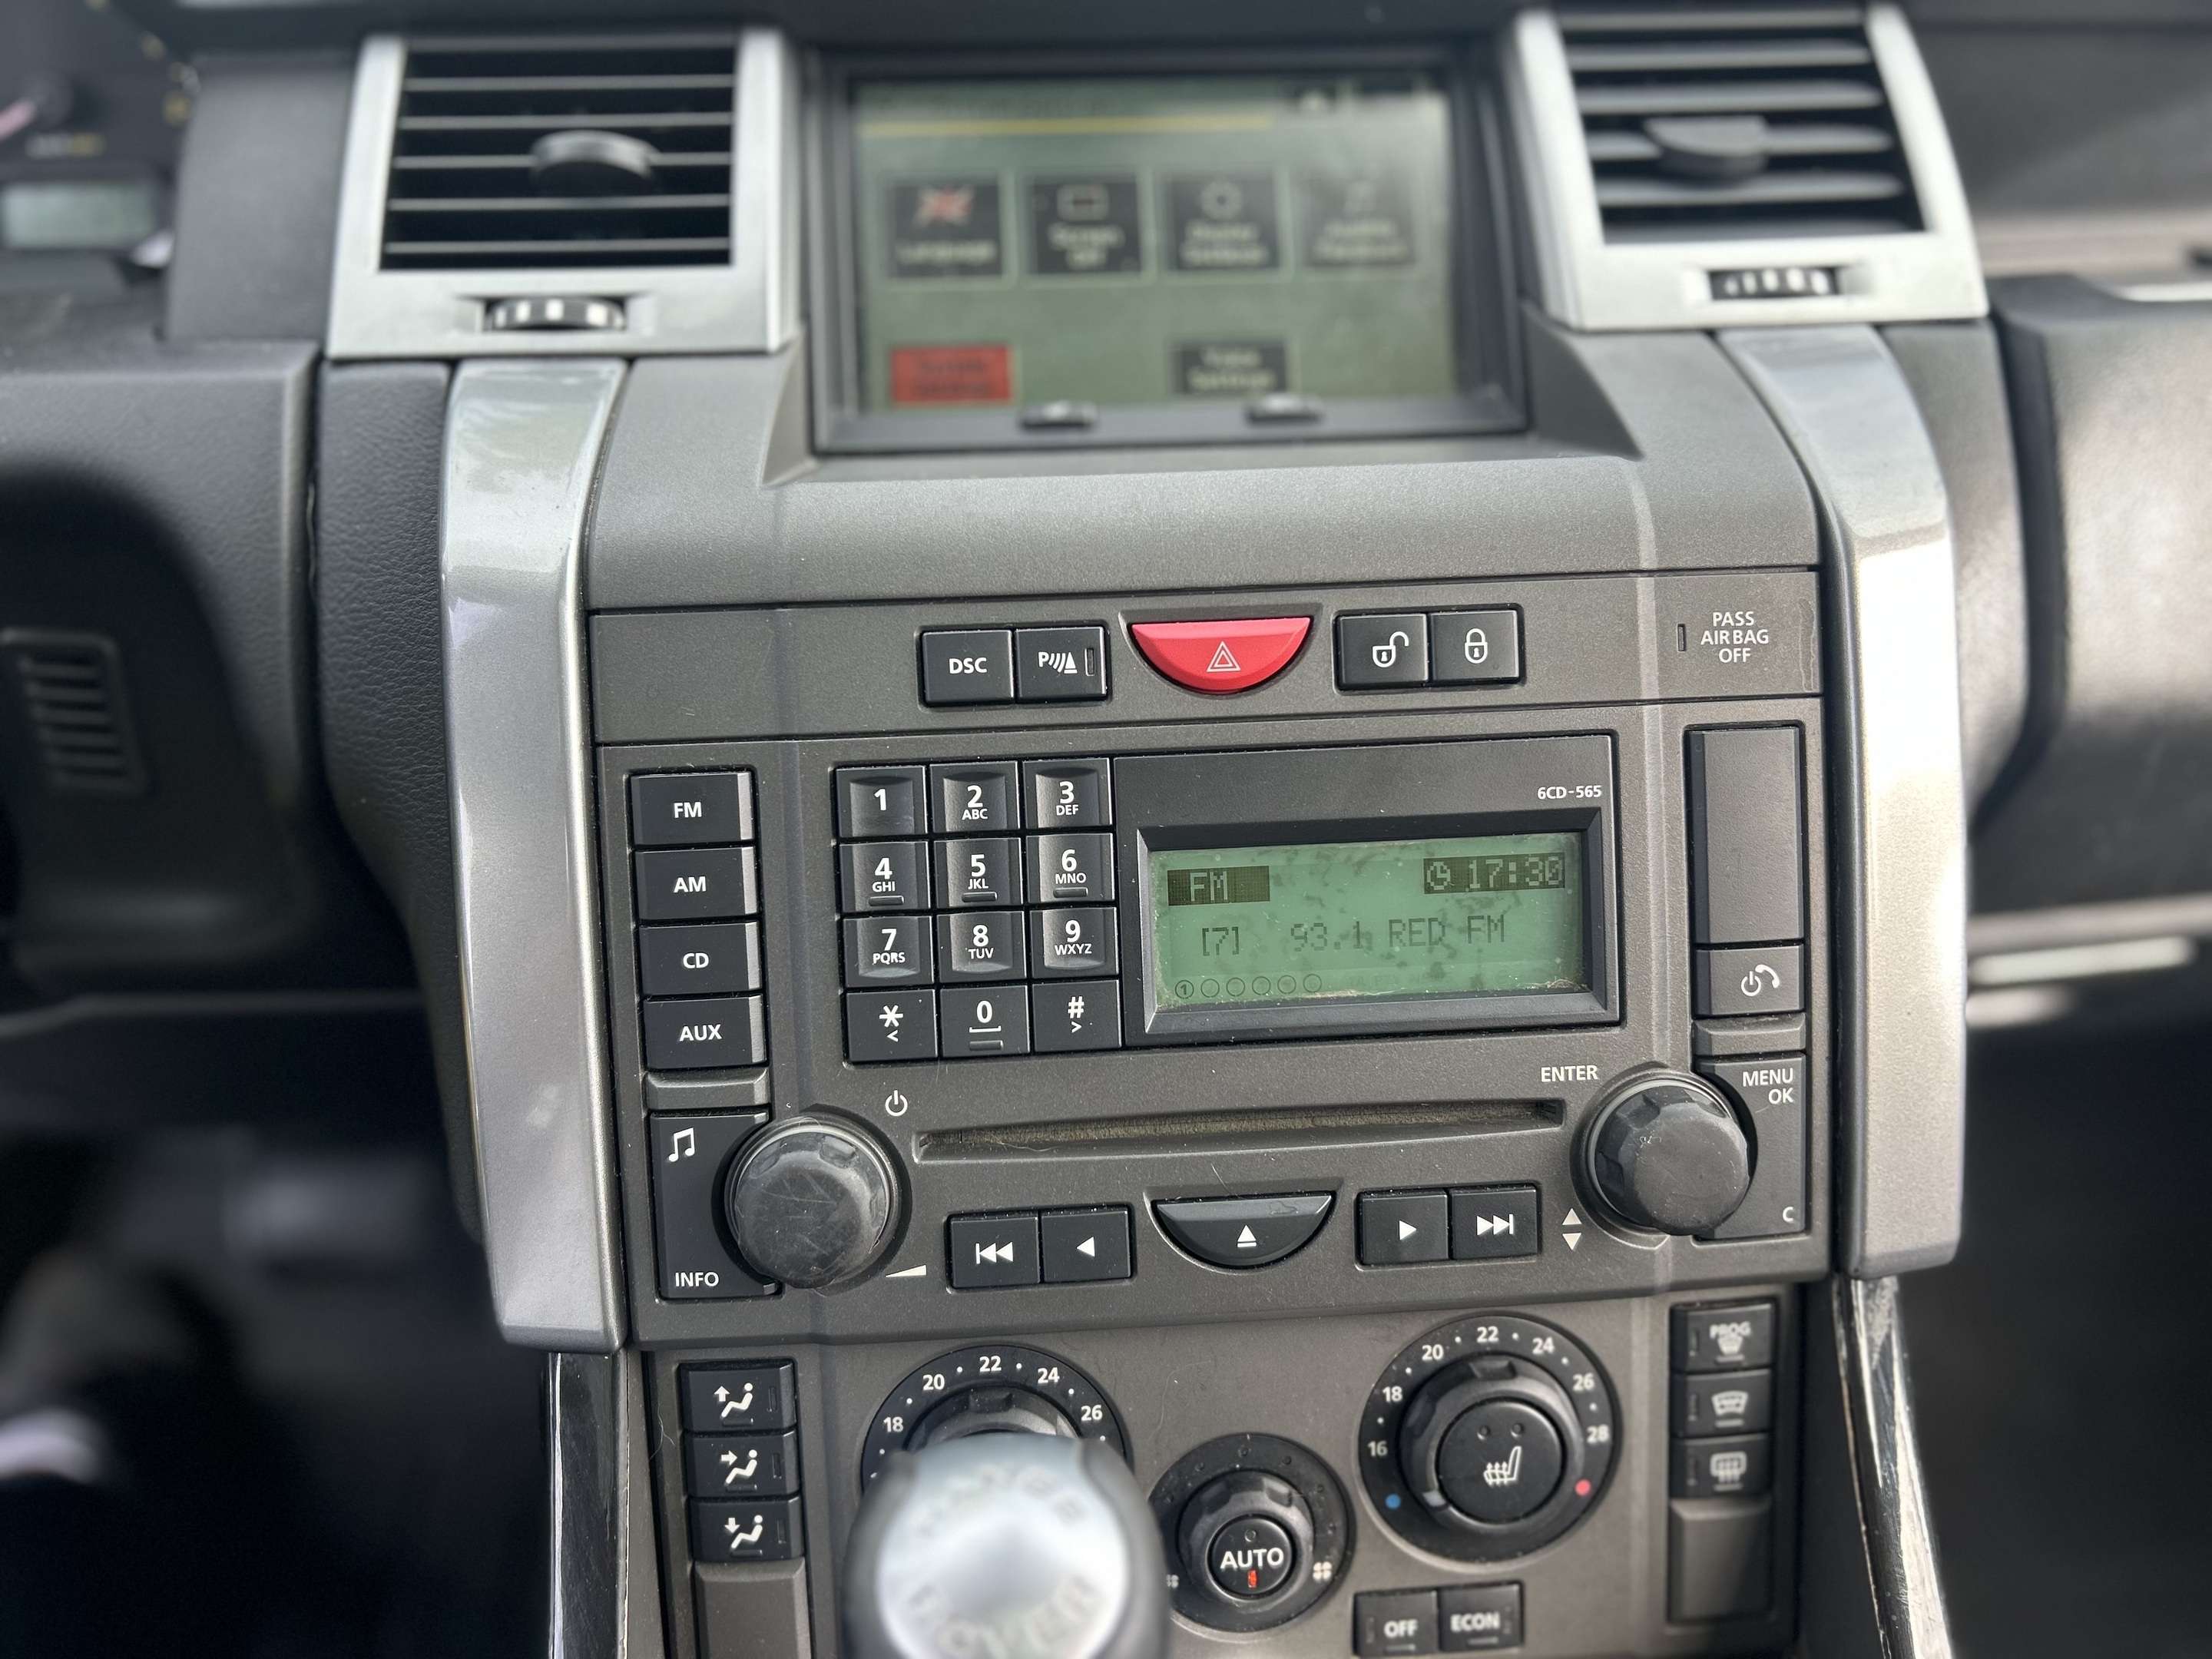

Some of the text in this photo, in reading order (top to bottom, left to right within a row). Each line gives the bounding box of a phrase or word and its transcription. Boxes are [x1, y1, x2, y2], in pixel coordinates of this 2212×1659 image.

[1713, 611, 1755, 627] PASS
[1718, 647, 1751, 664] OFF
[949, 657, 988, 674] DSC
[874, 788, 886, 811] 1
[966, 784, 984, 808] 2
[1058, 780, 1075, 804] 3
[1537, 784, 1602, 800] 6CD-565
[674, 801, 702, 819] FM
[961, 808, 989, 821] ABC
[1055, 804, 1079, 816] DEF
[874, 857, 892, 880] 4
[971, 854, 986, 877] 5
[1061, 849, 1078, 872] 6
[1055, 873, 1087, 885] MNO
[1469, 856, 1563, 889] 17:30
[674, 876, 707, 893] AM
[872, 881, 896, 892] GHI
[968, 878, 989, 890] JKL
[1190, 870, 1228, 902] FM
[881, 928, 897, 951] 7
[972, 924, 989, 947] 8
[1065, 919, 1081, 943] 9
[1290, 921, 1363, 952] 93.1
[1388, 917, 1445, 948] RED
[1467, 914, 1505, 945] FM
[872, 952, 906, 965] PQRS
[967, 947, 994, 959] TUV
[1054, 943, 1092, 956] WXYZ
[683, 952, 709, 969] CD
[976, 1000, 993, 1024] 0
[679, 1024, 723, 1041] AUX
[1541, 1065, 1599, 1082] ENTER
[1742, 1067, 1794, 1088] MENU
[1768, 1087, 1794, 1105] OK
[1782, 1206, 1793, 1223] C
[675, 1271, 719, 1287] INFO
[1477, 1326, 1498, 1343] 22
[1422, 1344, 1444, 1361] 20
[1532, 1336, 1555, 1355] 24
[979, 1355, 1002, 1373] 22
[922, 1373, 945, 1391] 20
[1038, 1366, 1060, 1384] 24
[1573, 1373, 1594, 1391] 26
[1382, 1386, 1402, 1402] 18
[1081, 1404, 1103, 1422] 26
[883, 1416, 904, 1432] 18
[1587, 1424, 1609, 1444] 28
[1368, 1441, 1387, 1456] 16
[1220, 1547, 1284, 1570] AUTO
[1384, 1619, 1417, 1638] OFF
[1451, 1612, 1500, 1631] ECON
